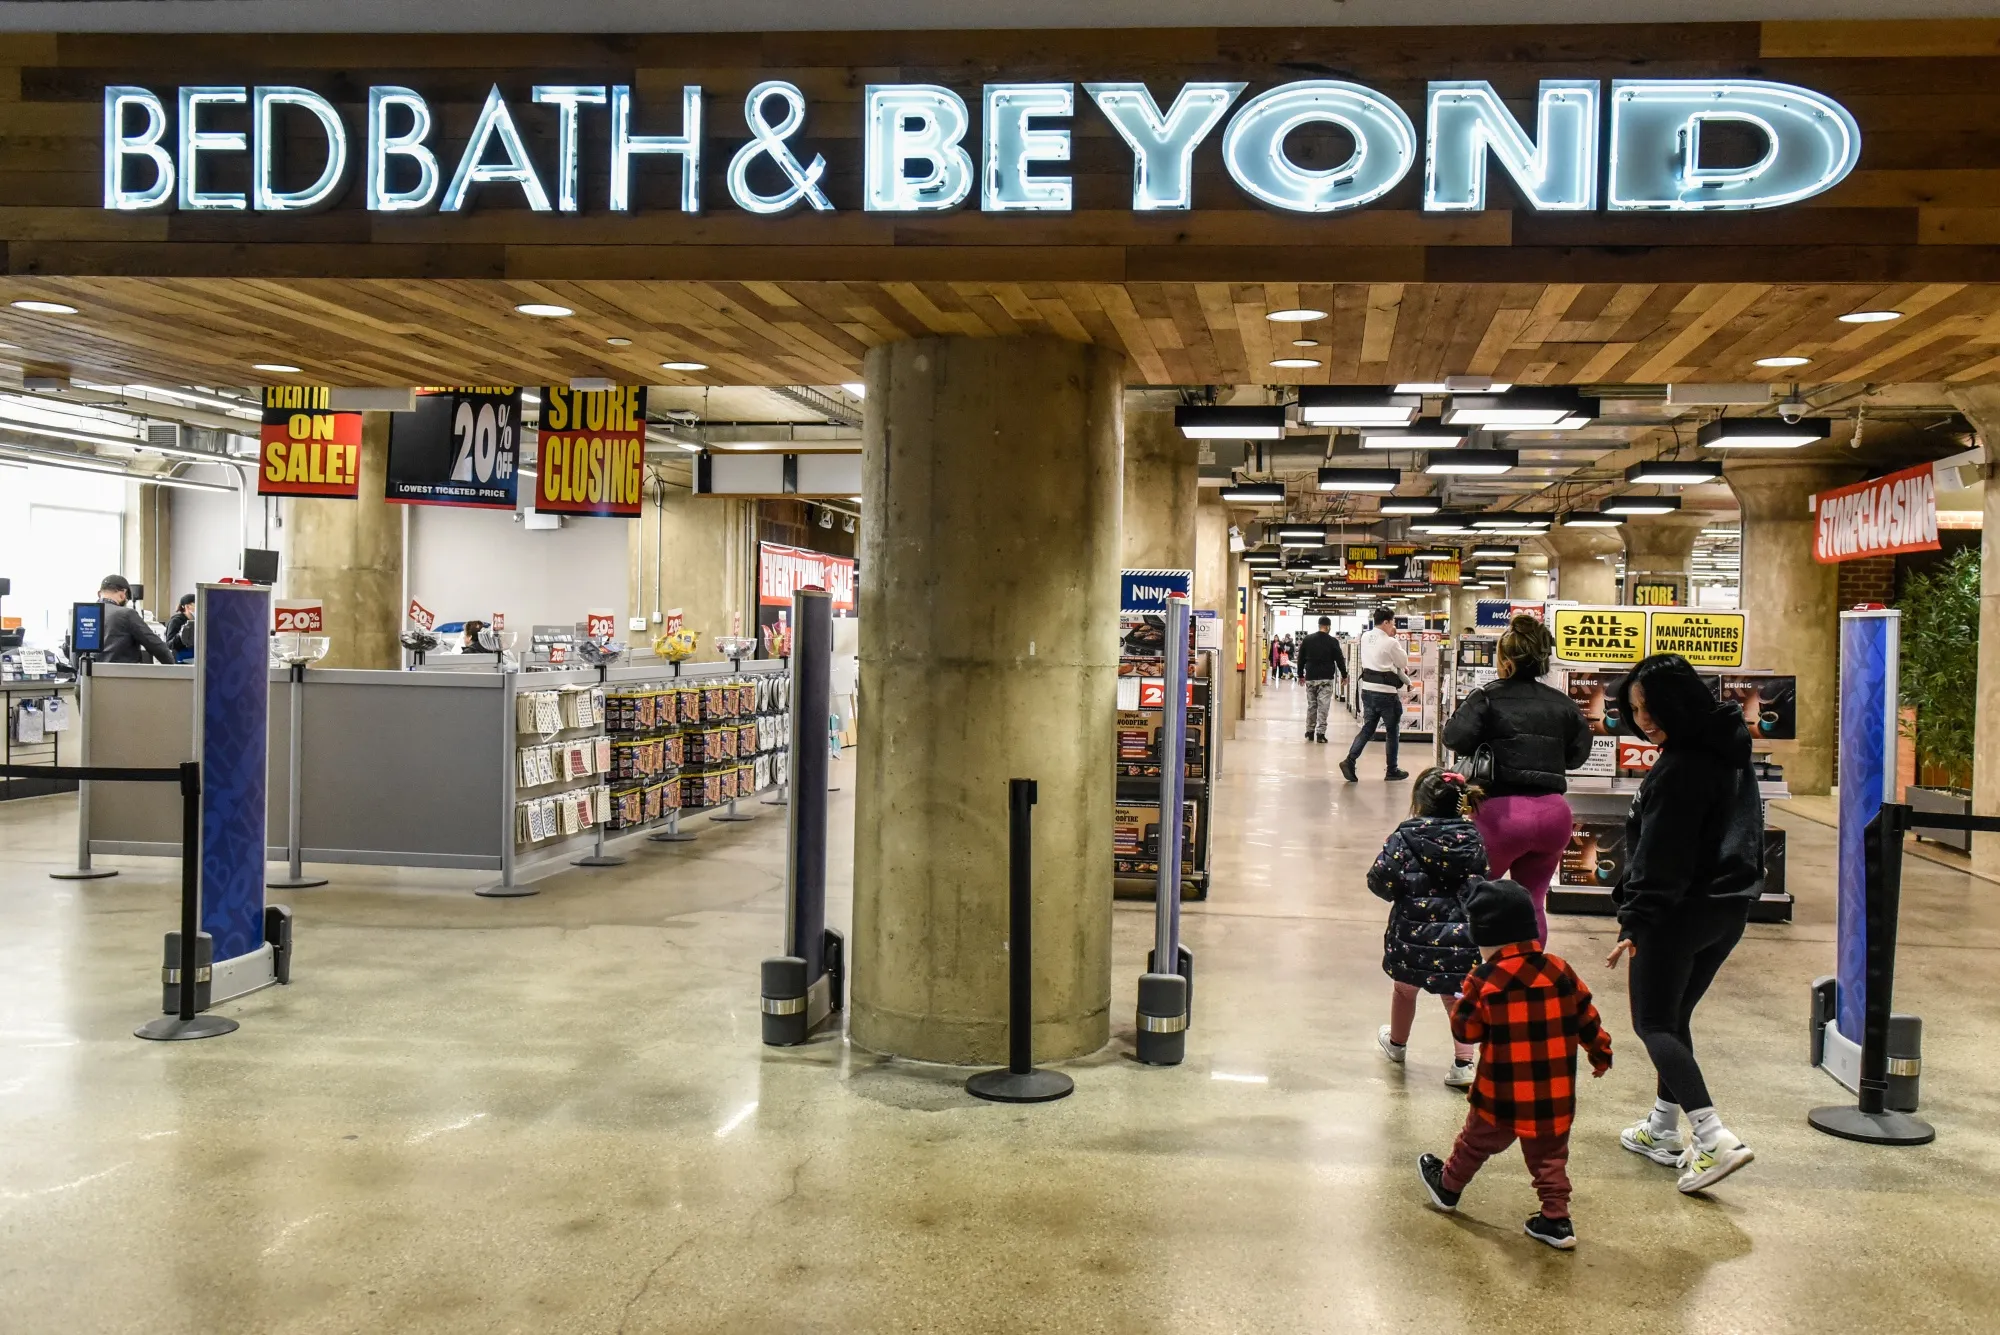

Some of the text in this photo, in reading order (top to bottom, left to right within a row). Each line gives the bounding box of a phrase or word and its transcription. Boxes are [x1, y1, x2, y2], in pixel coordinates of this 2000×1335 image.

[104, 80, 1861, 214] BED BATH & BEYOND
[288, 413, 335, 441] ON
[450, 401, 512, 483] 20%
[265, 442, 357, 485] SALE!
[495, 451, 513, 480] OFF
[544, 435, 641, 504] CLOSING
[399, 484, 506, 498] LOWEST TICKETED PRICE
[1348, 547, 1378, 561] EVERYTHING
[1348, 568, 1377, 581] SALE!
[1431, 562, 1460, 582] CLOSING
[1132, 583, 1173, 604] NINJA
[1635, 585, 1675, 606] STORE
[278, 611, 320, 630] 20%
[1491, 607, 1511, 620] welc
[1579, 615, 1622, 625] ALL
[309, 621, 321, 629] OFF
[590, 618, 614, 635] 20%
[1683, 617, 1712, 625] ALL
[1562, 625, 1639, 637] SALES
[1656, 625, 1739, 639] MANUFACTURERS
[1564, 637, 1636, 649] FINAL
[1656, 639, 1738, 653] WARRANTIES
[1593, 740, 1614, 748] PONS
[1621, 748, 1662, 767] 20
[1115, 815, 1139, 823] ODFIRE
